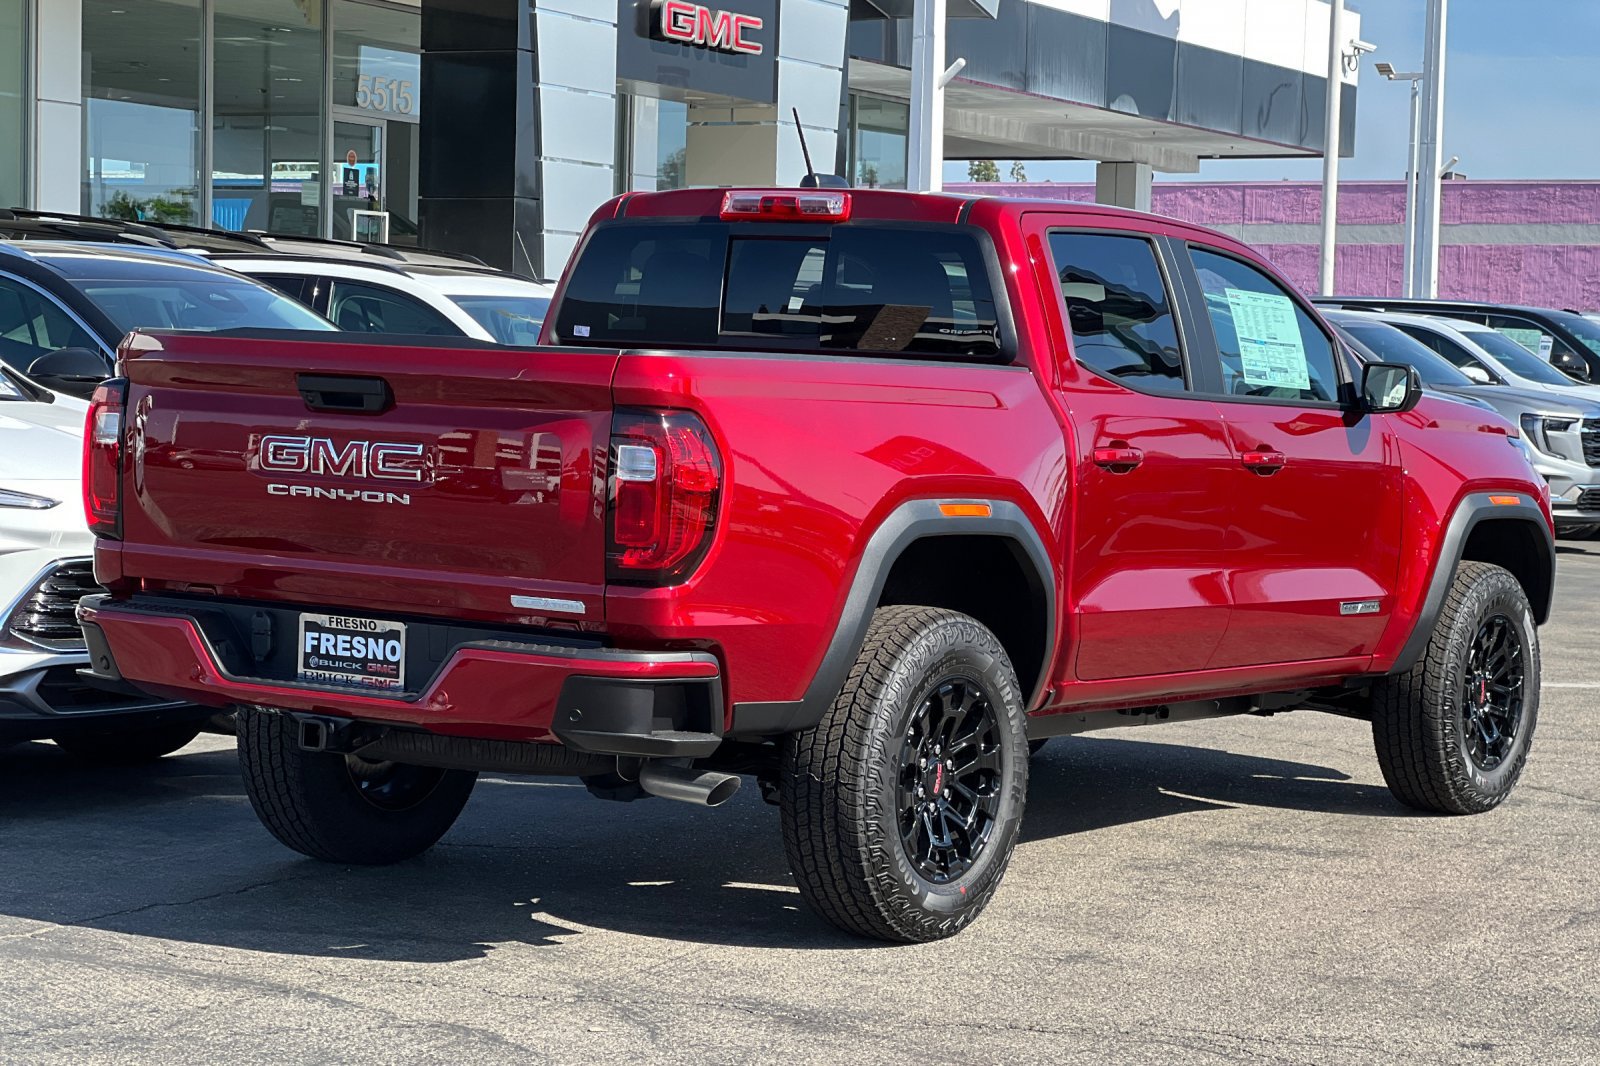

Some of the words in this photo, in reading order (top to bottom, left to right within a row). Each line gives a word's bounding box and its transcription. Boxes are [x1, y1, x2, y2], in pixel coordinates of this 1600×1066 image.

[661, 0, 763, 55] GMC
[356, 74, 413, 114] 5515
[260, 435, 424, 482] GMC
[267, 483, 410, 505] CANYON
[328, 616, 377, 631] FRESNO
[305, 631, 401, 662] FRESNO
[319, 659, 362, 670] BUICK
[366, 662, 397, 674] GMC
[993, 669, 1021, 804] WRANGLER
[933, 763, 943, 794] GMC
